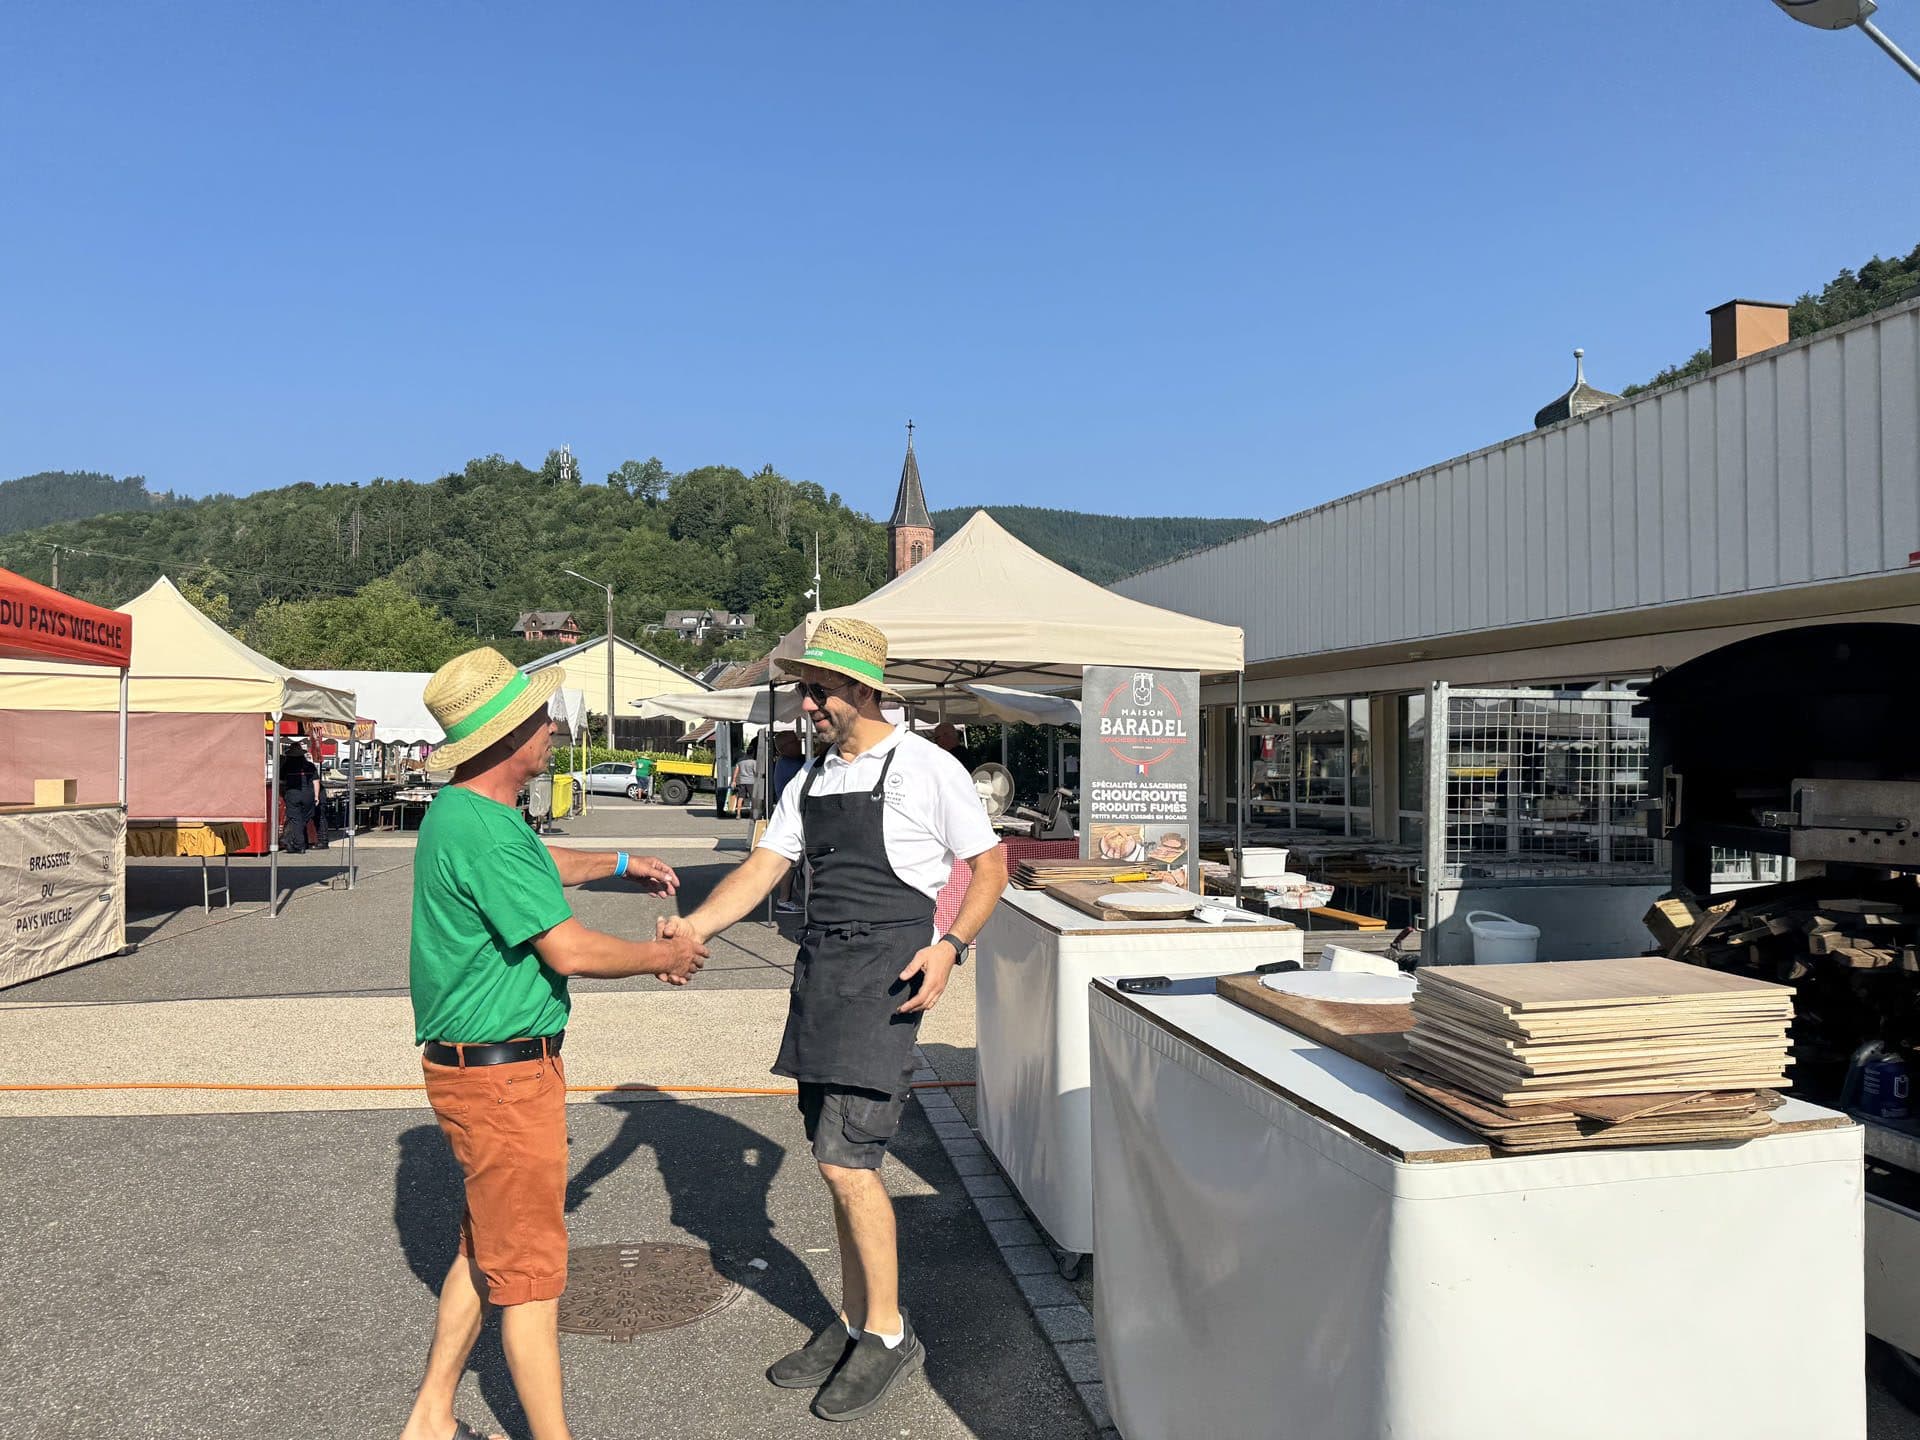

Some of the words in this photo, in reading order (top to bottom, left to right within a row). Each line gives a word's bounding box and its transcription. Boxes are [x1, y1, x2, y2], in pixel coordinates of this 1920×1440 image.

[0, 599, 24, 628] DU
[29, 605, 67, 637] PAYS
[70, 615, 122, 649] WELCHE
[1121, 708, 1164, 717] MAISON
[1099, 717, 1187, 737] BARADEL
[1091, 780, 1138, 789] SPÉCIALITÉS
[1139, 782, 1187, 790] ALSACIENNES
[1091, 789, 1187, 802] CHOUCROUTE
[1091, 802, 1147, 812] PRODUITS
[1149, 801, 1187, 813] FUMÉS
[29, 852, 71, 871] BRASSERIE
[41, 882, 55, 898] DU
[16, 914, 39, 933] PAYS
[40, 907, 73, 928] WELCHE
